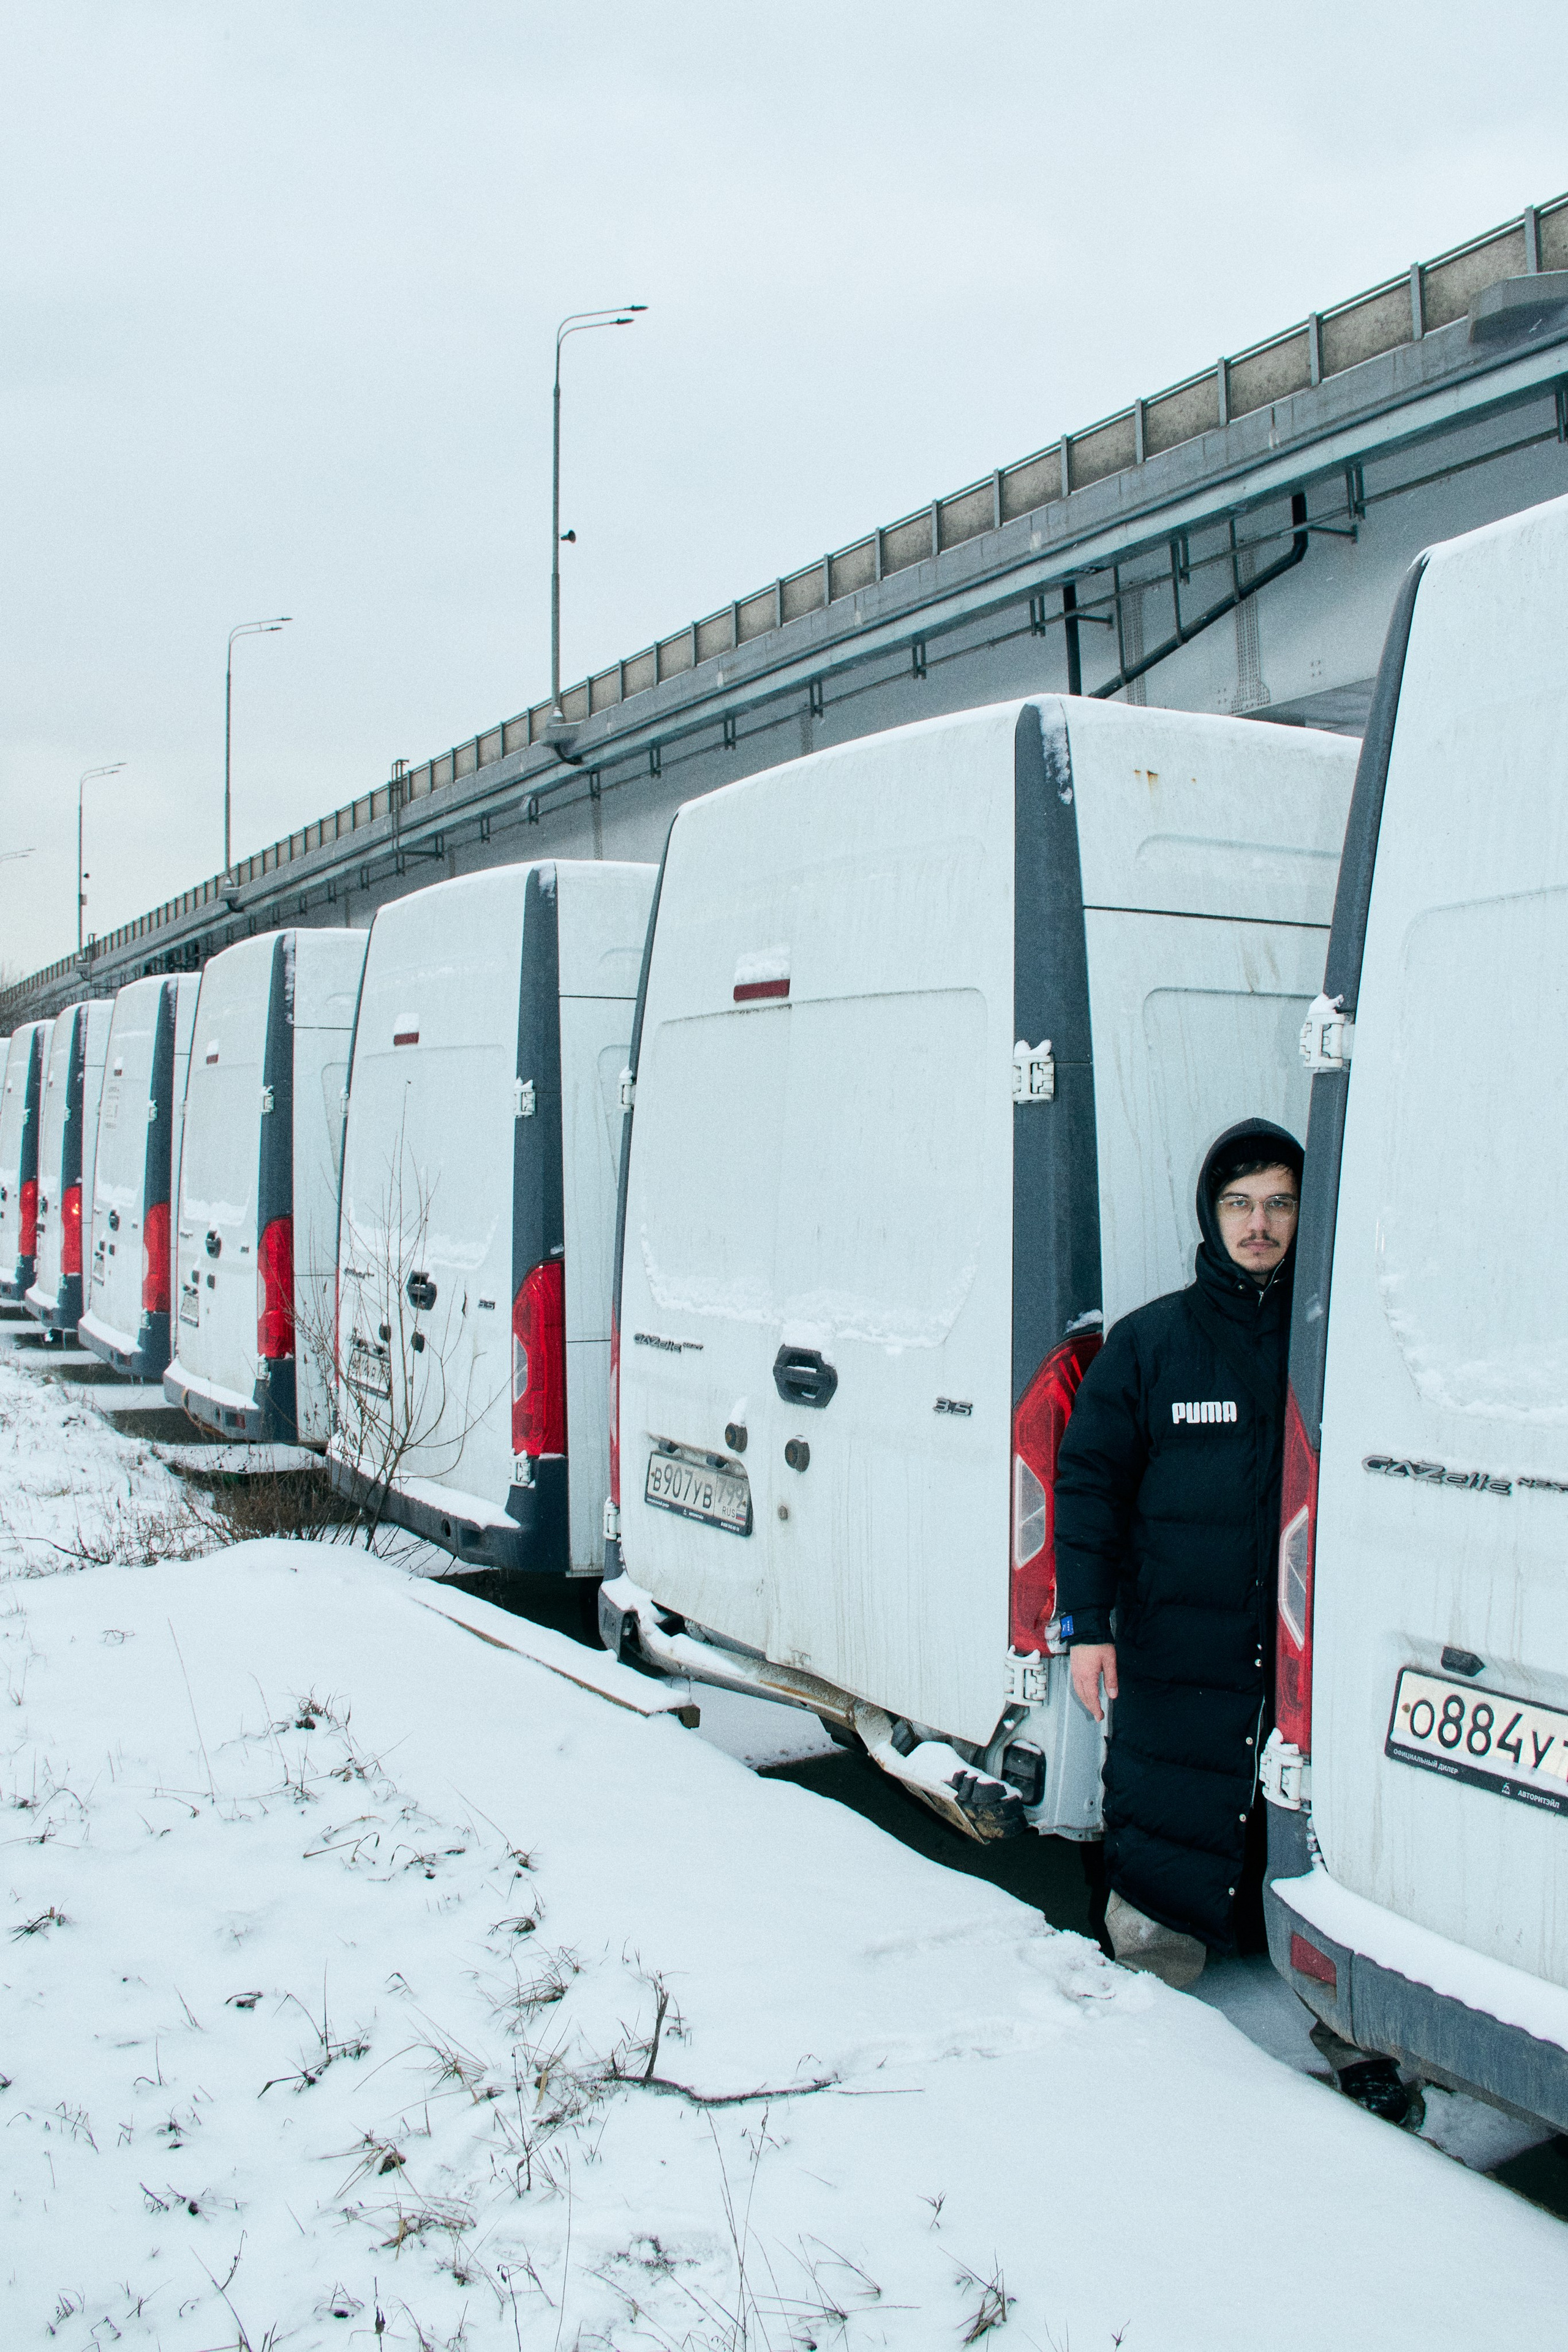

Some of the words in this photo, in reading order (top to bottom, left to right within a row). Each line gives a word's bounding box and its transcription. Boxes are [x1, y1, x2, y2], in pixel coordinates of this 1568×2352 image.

[1172, 1401, 1237, 1424] PUMA
[1361, 1454, 1512, 1496] GAZelle
[722, 1506, 736, 1518] RUS
[1393, 1748, 1438, 1768] ОФИЦИАЛЬНЫЙ
[1438, 1763, 1458, 1774] ДИЛЕР
[1517, 1790, 1560, 1809] АВТОРИТЭЙЛ
